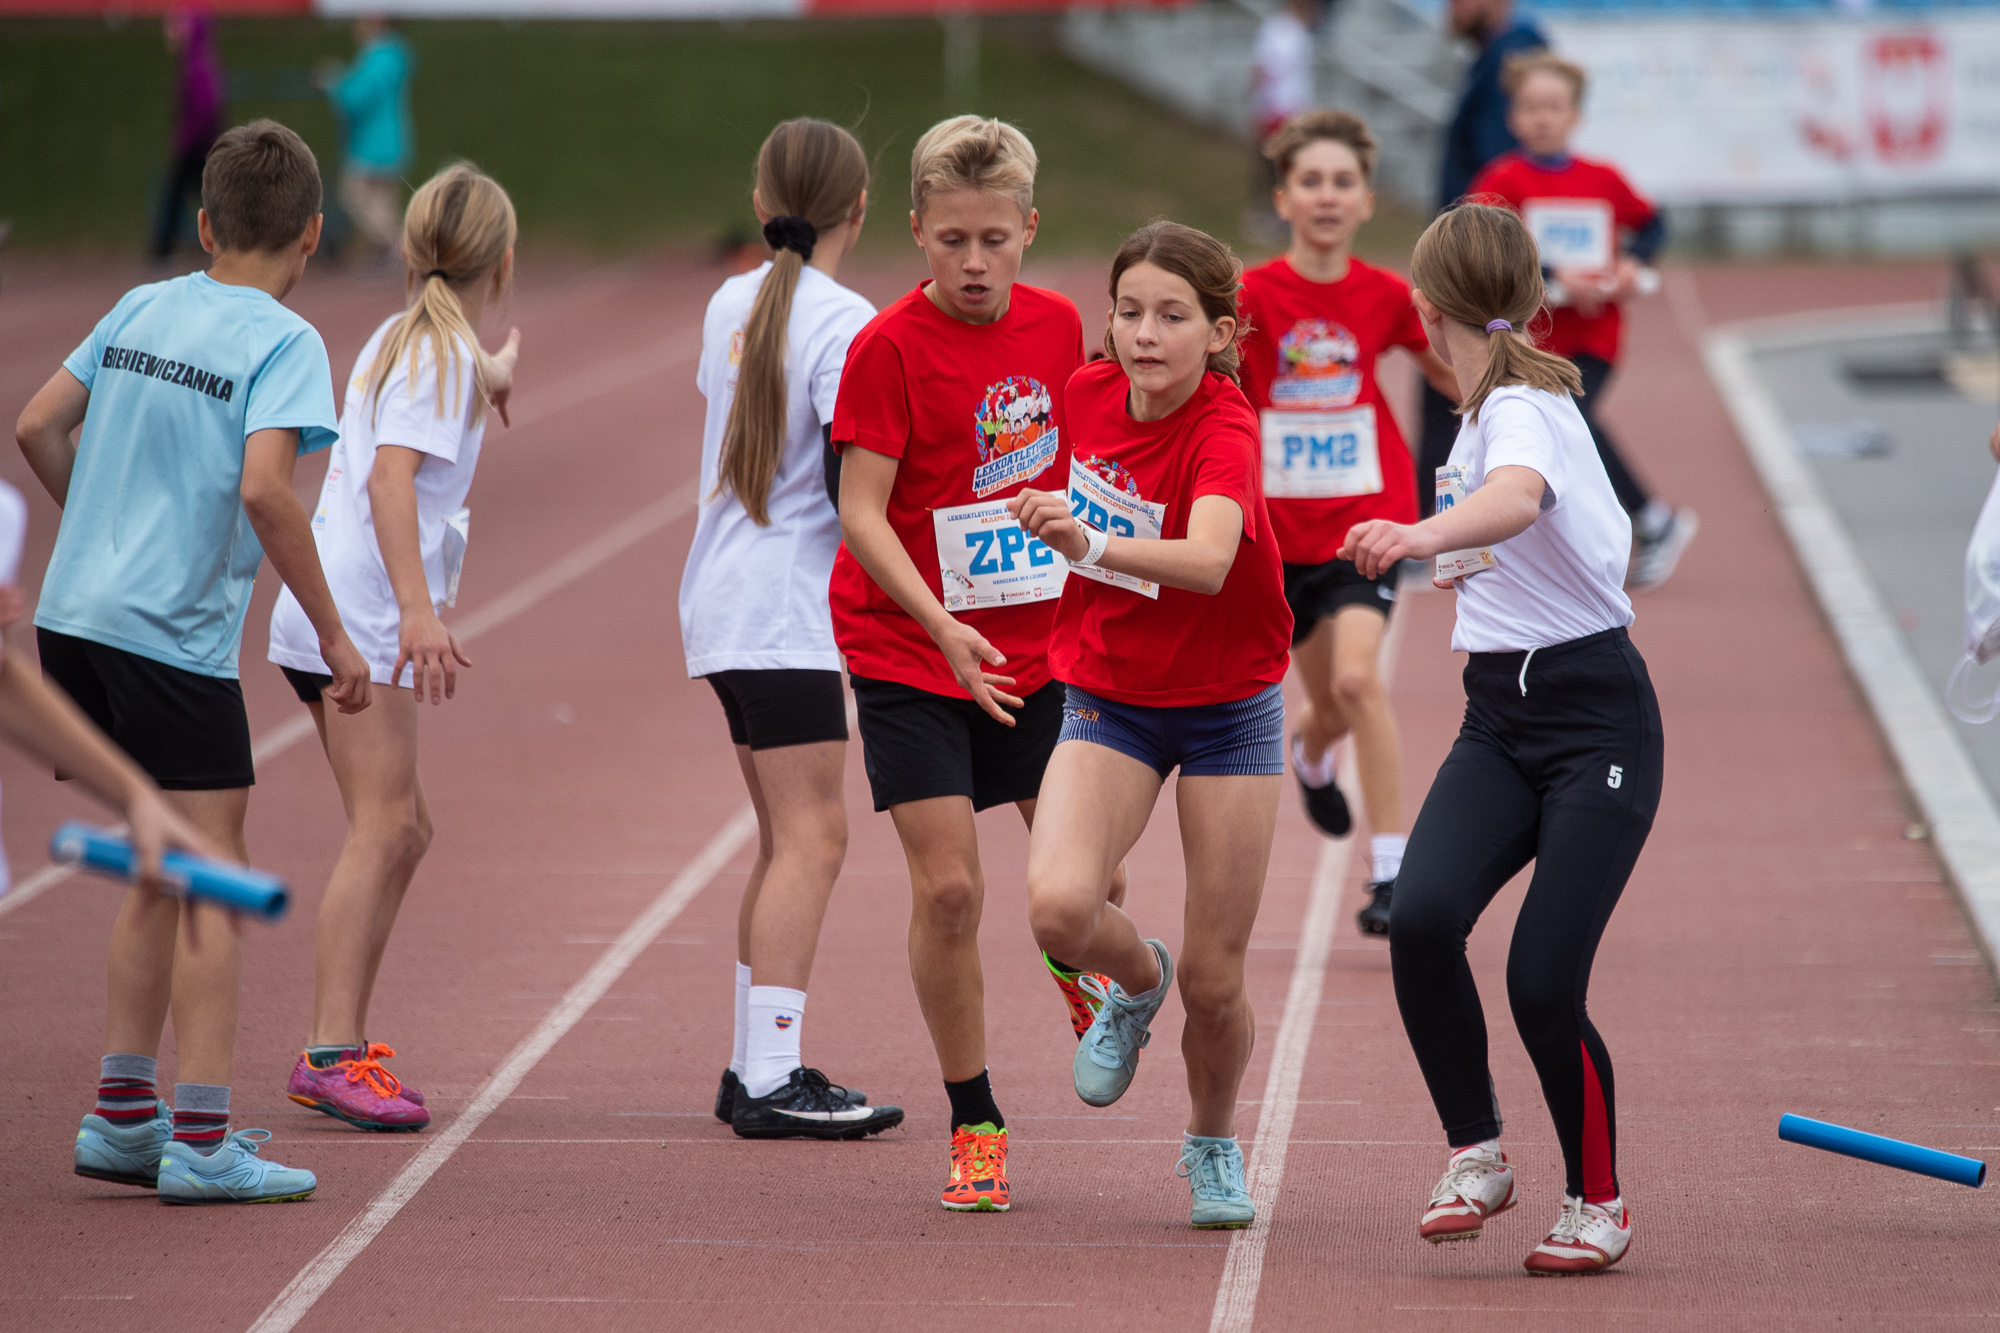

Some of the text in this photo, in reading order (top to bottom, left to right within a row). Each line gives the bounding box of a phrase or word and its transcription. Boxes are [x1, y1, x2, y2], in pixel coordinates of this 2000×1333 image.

[101, 346, 234, 403] BIENIEWICZANKA
[975, 428, 1057, 480] LEKKOATLETYCZNE
[1283, 434, 1358, 468] PM2
[974, 465, 1015, 491] NADZIEJE
[1607, 764, 1623, 789] 5
